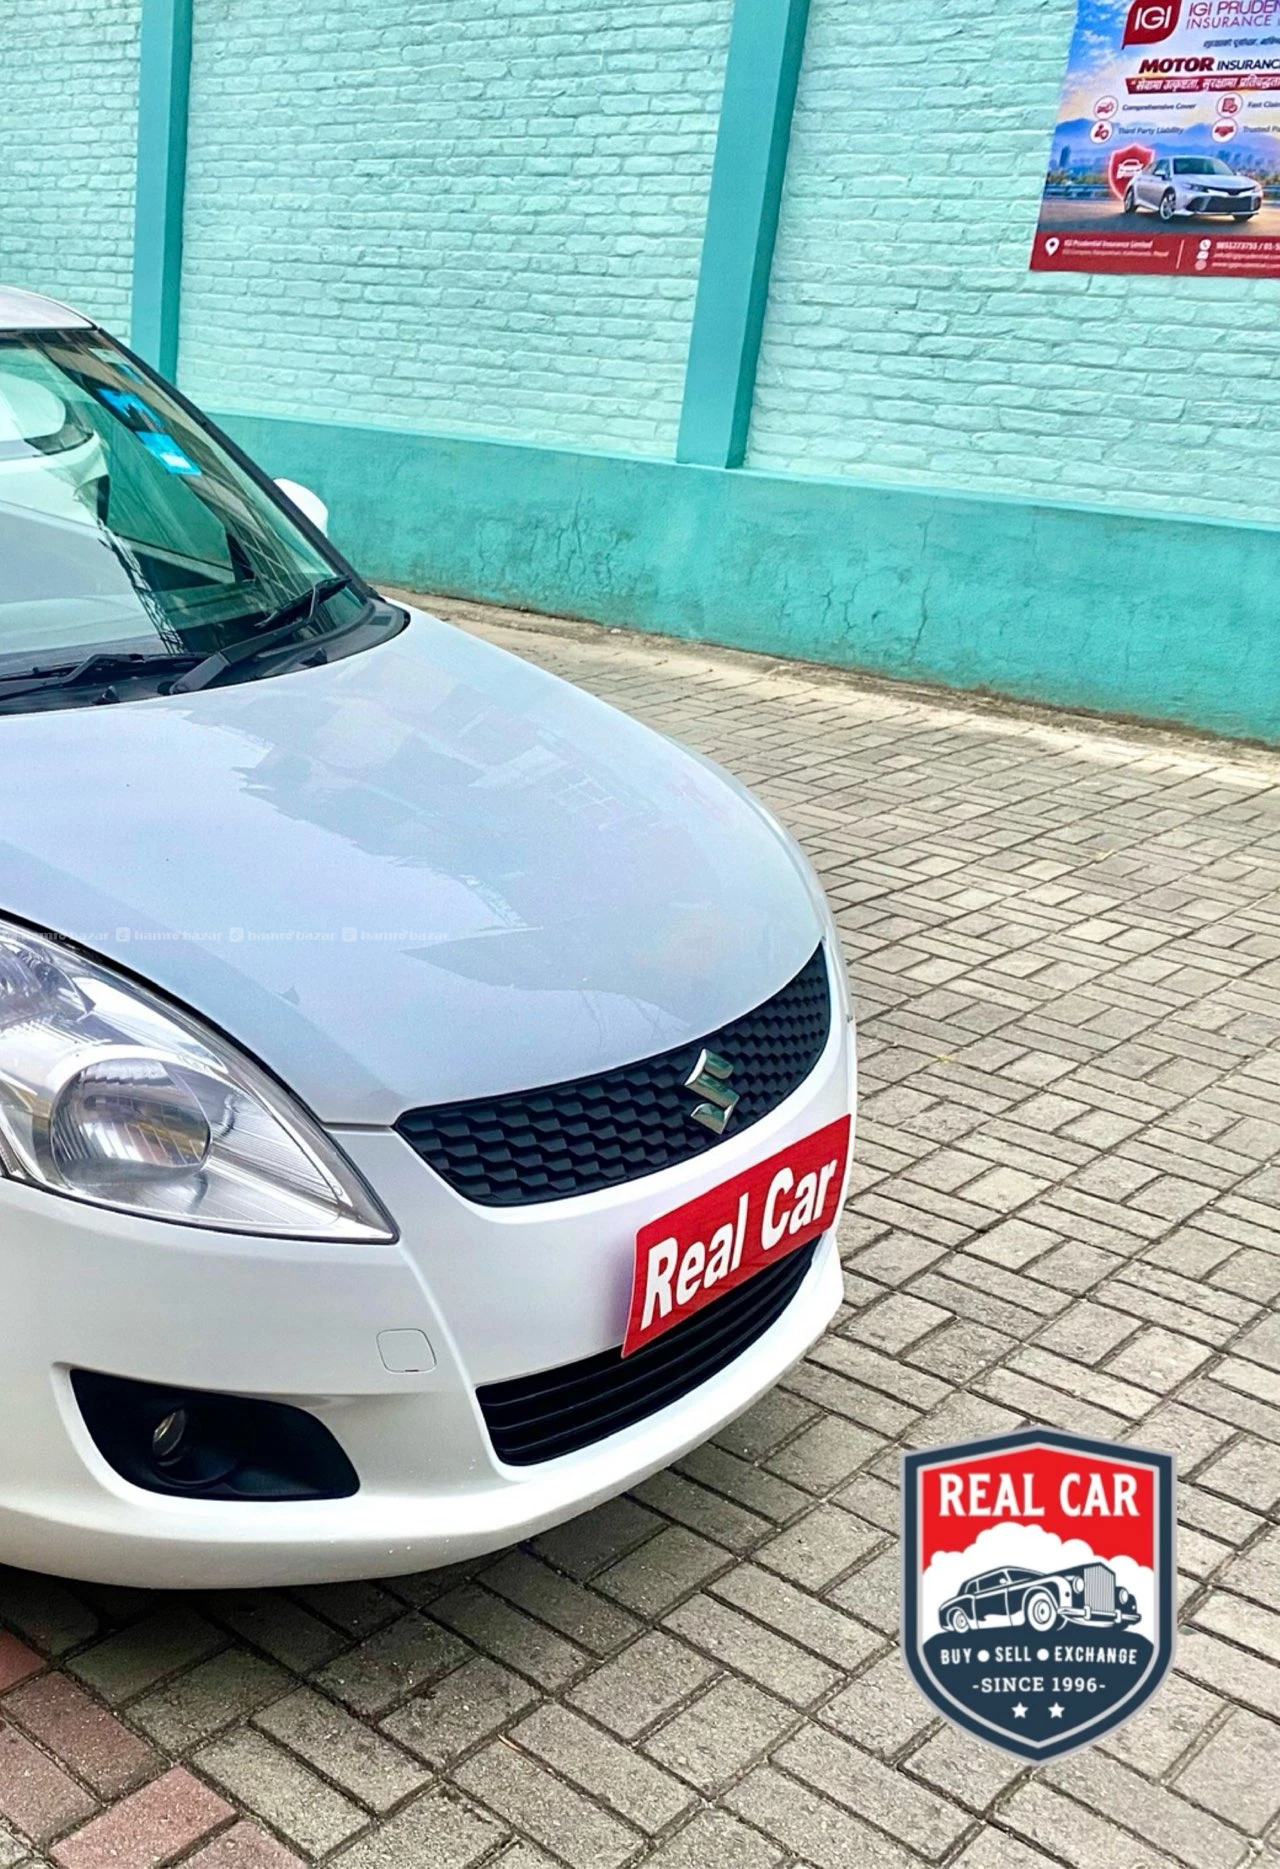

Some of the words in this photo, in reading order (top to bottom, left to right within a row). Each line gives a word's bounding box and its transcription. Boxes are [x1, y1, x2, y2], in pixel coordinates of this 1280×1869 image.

[1189, 2, 1213, 17] IGI
[1135, 5, 1172, 30] IGI
[1186, 14, 1273, 30] INSURANCE
[1138, 57, 1215, 74] MOTOR
[1217, 58, 1280, 71] INSURANC
[1122, 103, 1174, 112] Comprehensive
[1175, 102, 1196, 110] Cover
[1118, 127, 1136, 135] Third
[1137, 127, 1155, 136] Party
[1156, 126, 1184, 135] Liability
[1243, 125, 1271, 133] Trusted
[639, 1192, 749, 1332] Real
[760, 1158, 838, 1251] Car
